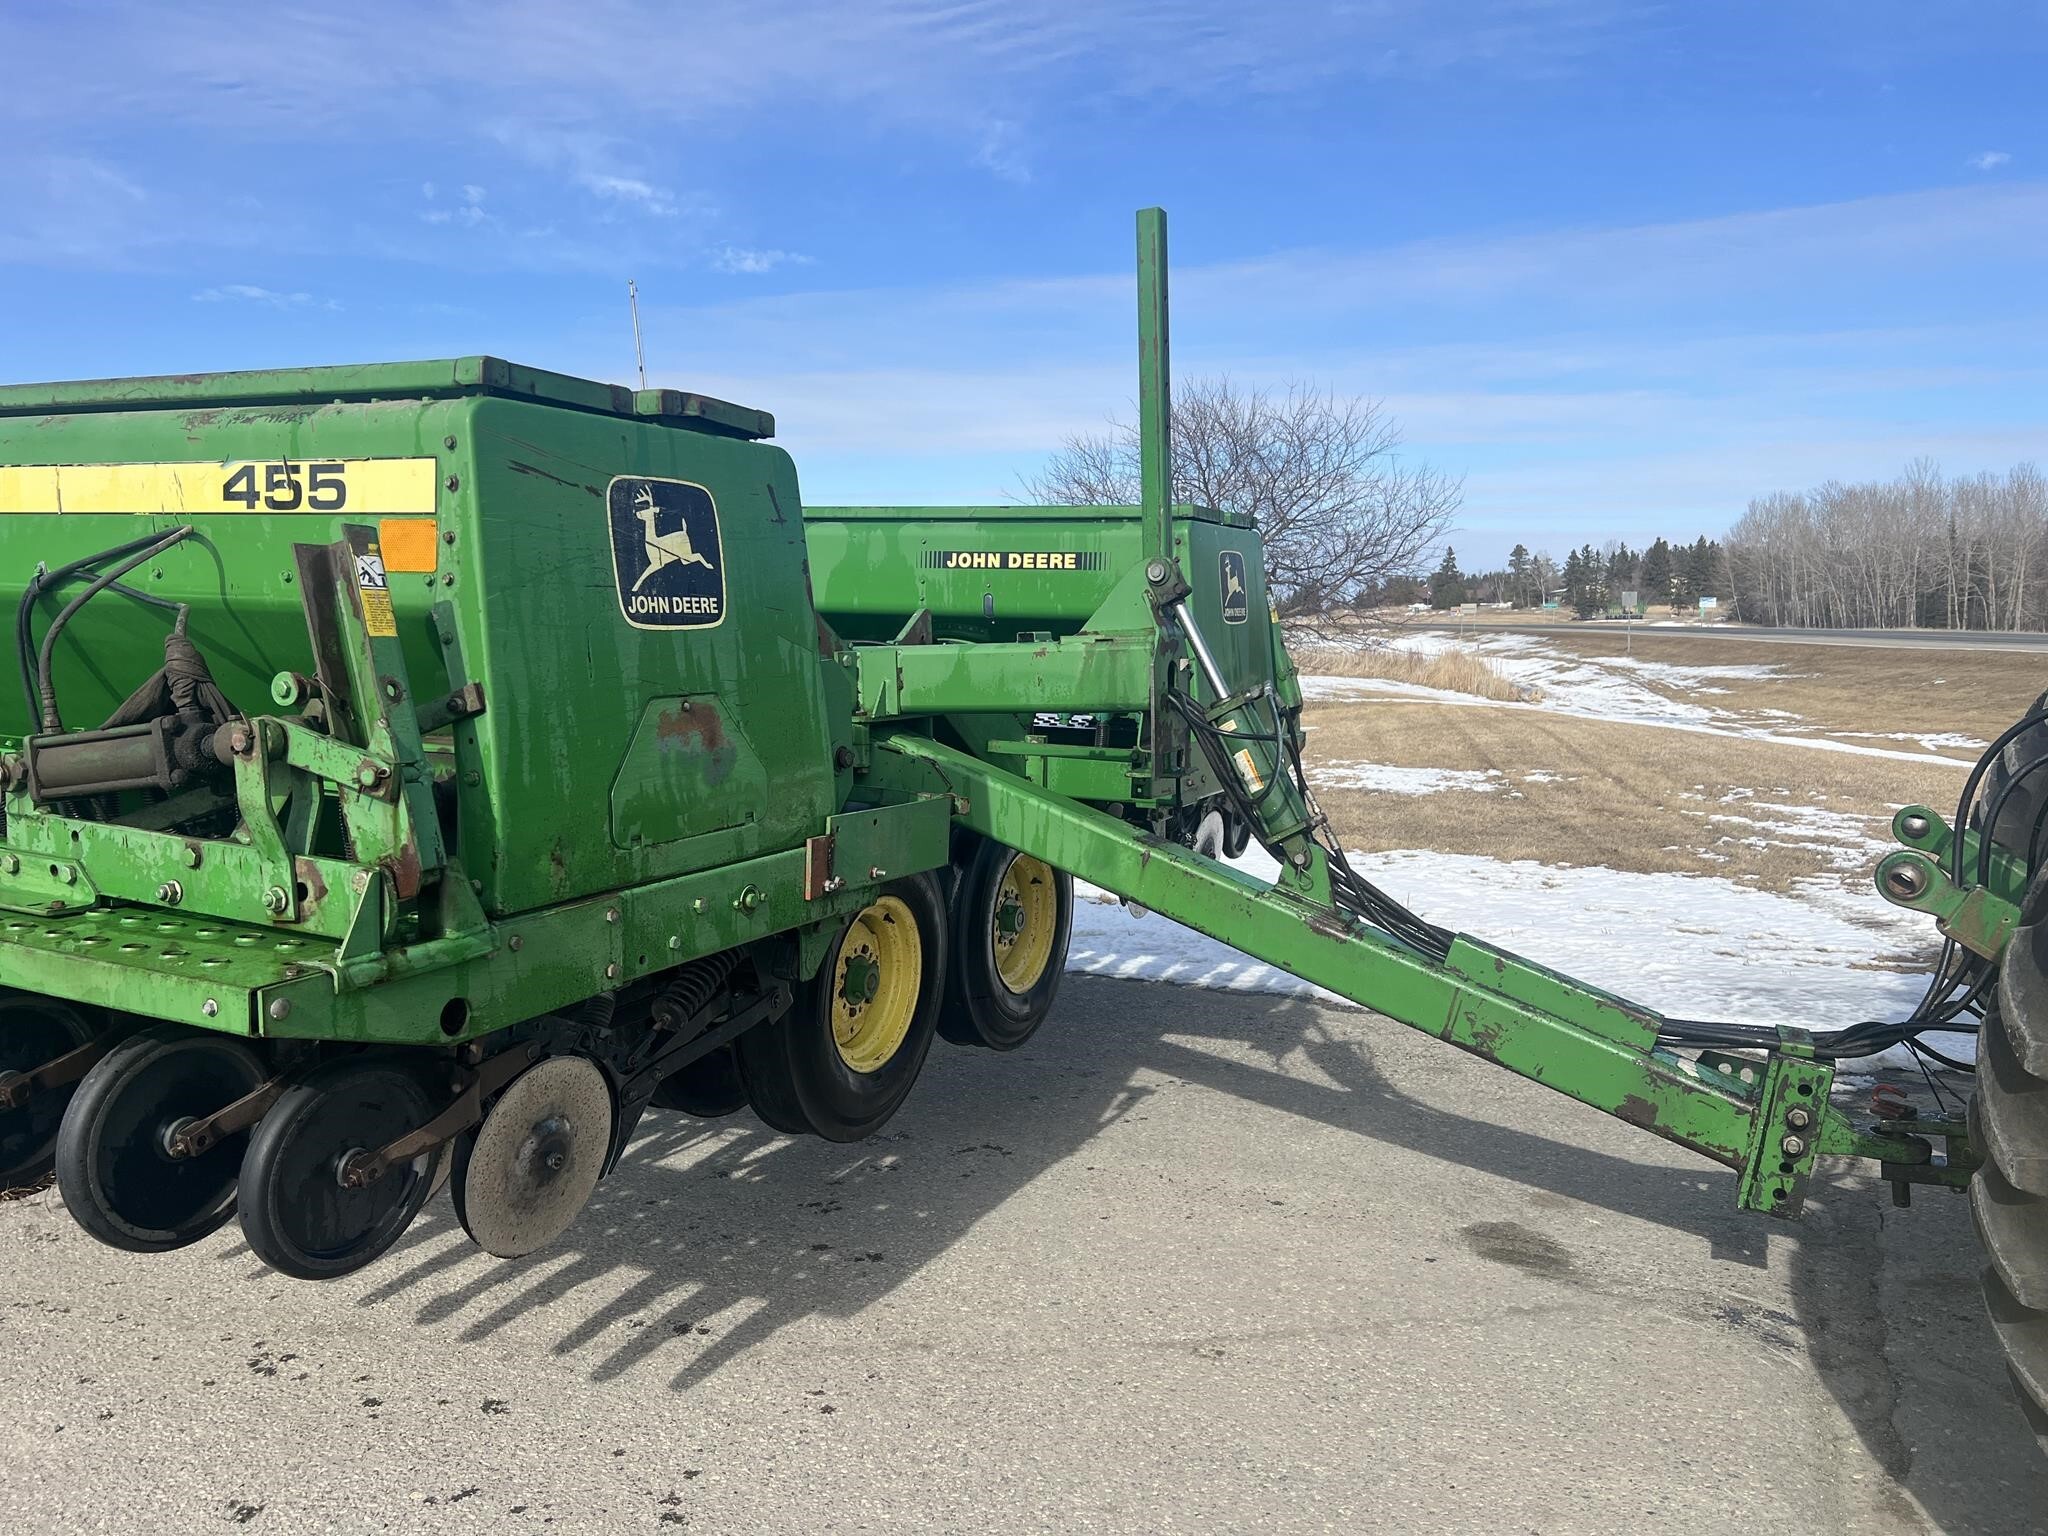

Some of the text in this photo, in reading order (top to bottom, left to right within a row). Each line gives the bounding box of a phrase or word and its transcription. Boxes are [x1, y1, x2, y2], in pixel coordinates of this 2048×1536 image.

[222, 463, 347, 511] 455
[946, 552, 1077, 569] JOHN DEERE
[628, 595, 719, 614] JOHN DEERE
